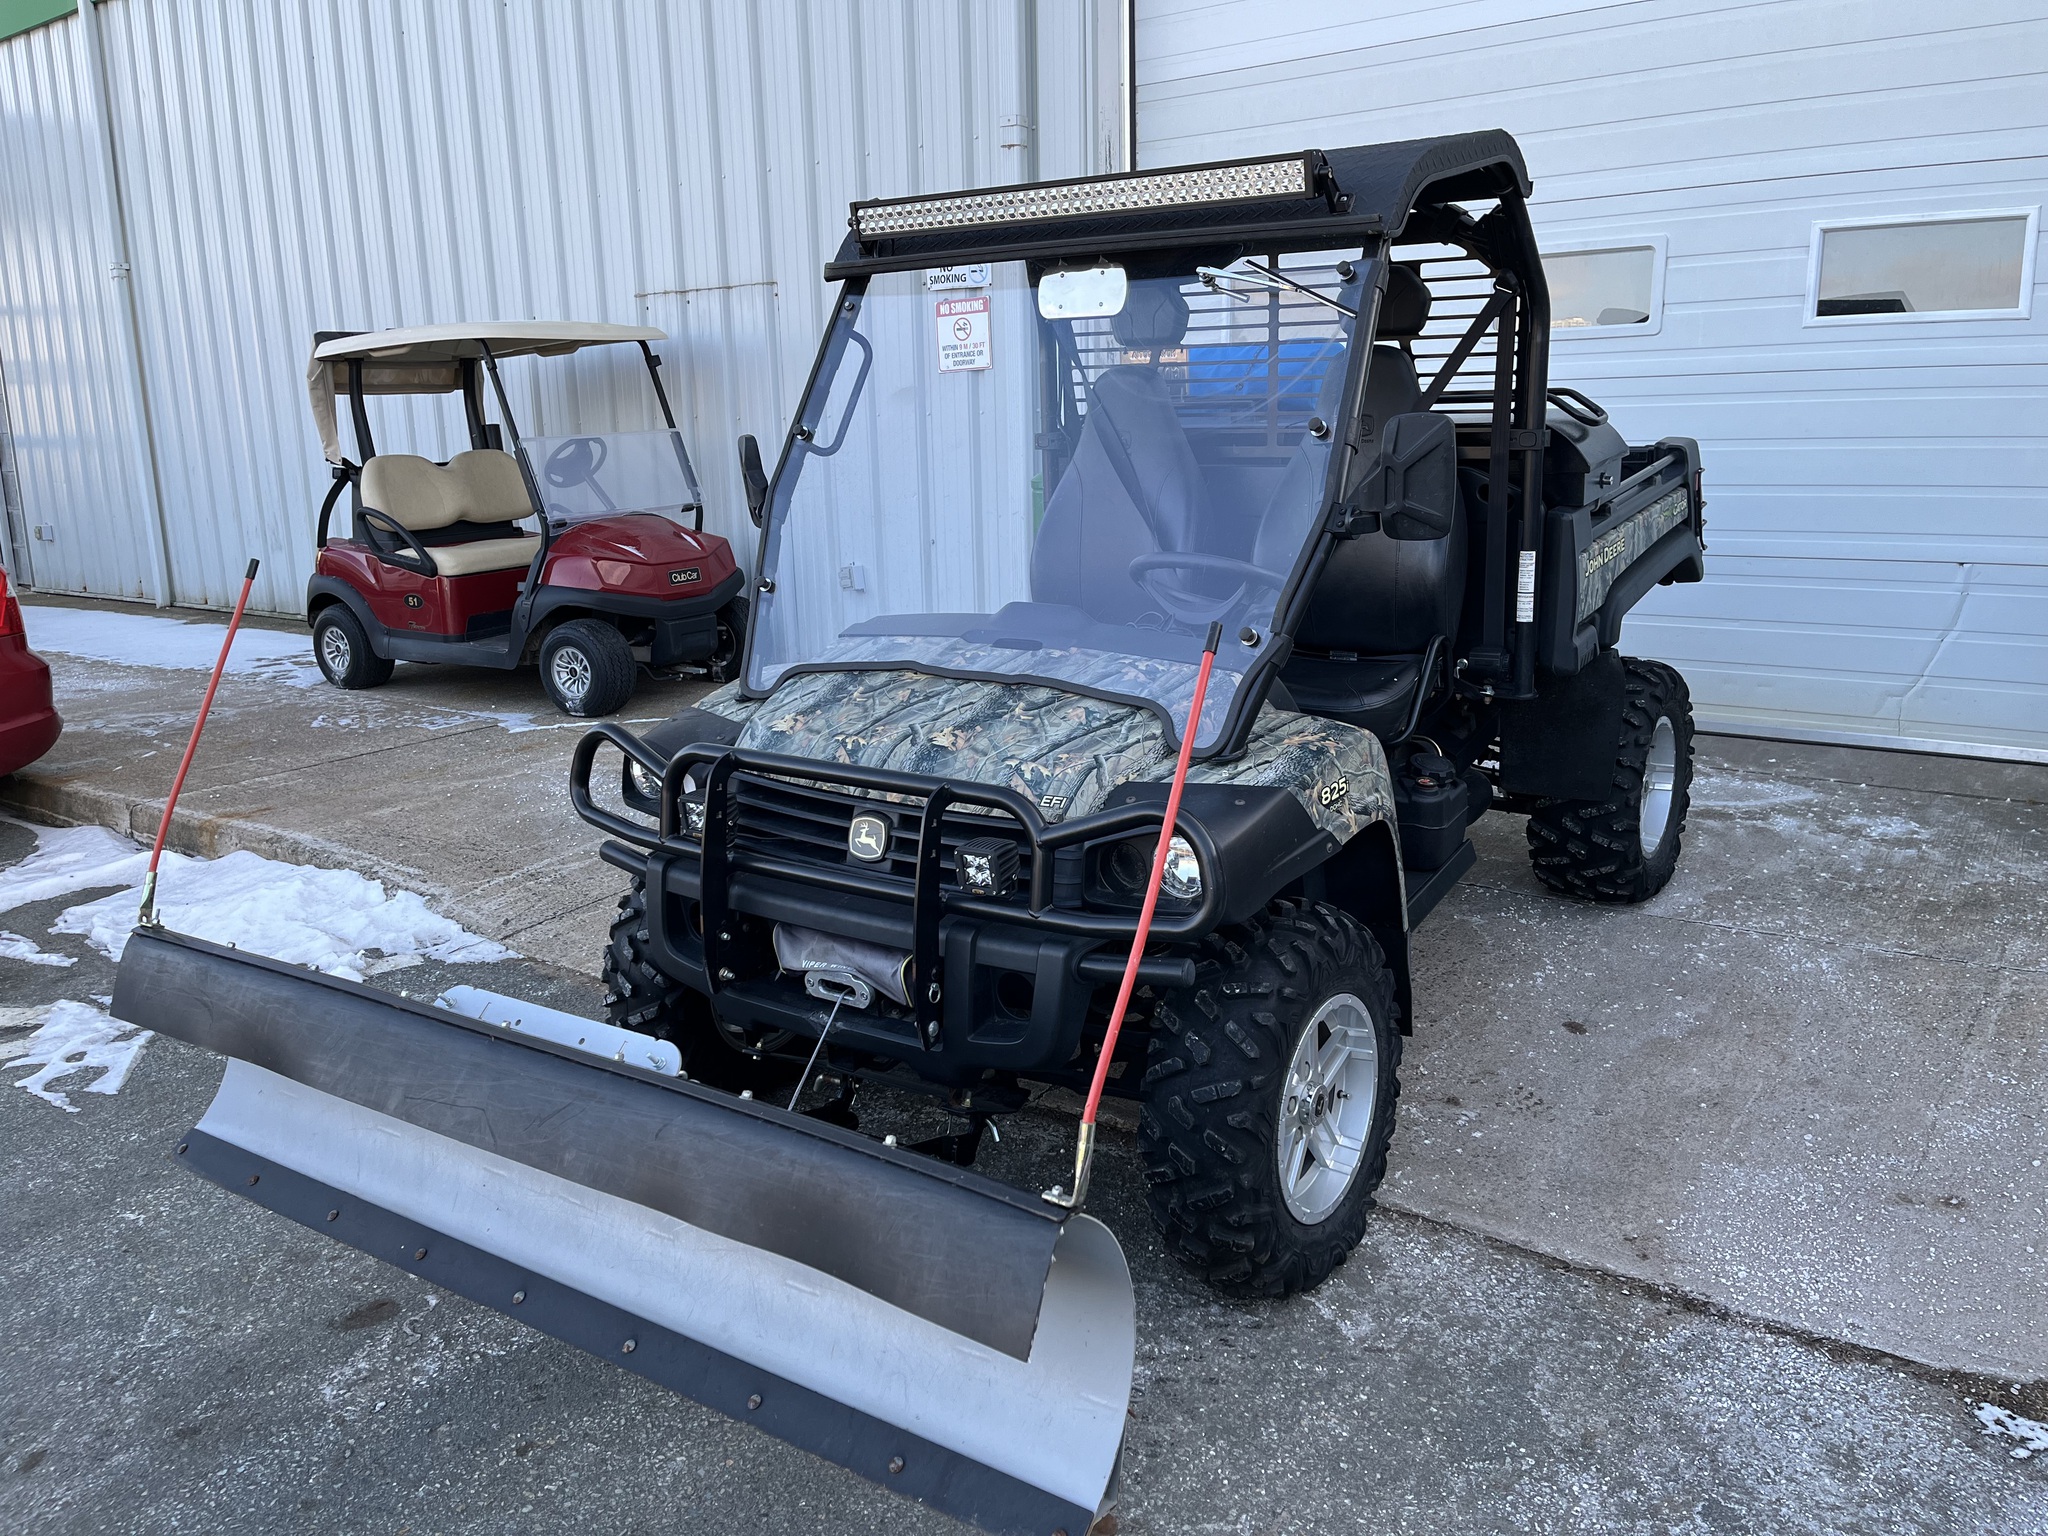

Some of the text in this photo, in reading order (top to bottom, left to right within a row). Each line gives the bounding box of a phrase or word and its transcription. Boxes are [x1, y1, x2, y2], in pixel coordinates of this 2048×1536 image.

[929, 273, 967, 285] SMOKING
[940, 300, 984, 315] NO SMOKING
[951, 350, 976, 359] ENTRANCE
[952, 358, 976, 366] DOORWAY
[1585, 538, 1626, 577] JOHN DEERE
[408, 596, 418, 606] 51
[1040, 795, 1067, 808] EFI
[802, 960, 828, 968] VIPER
